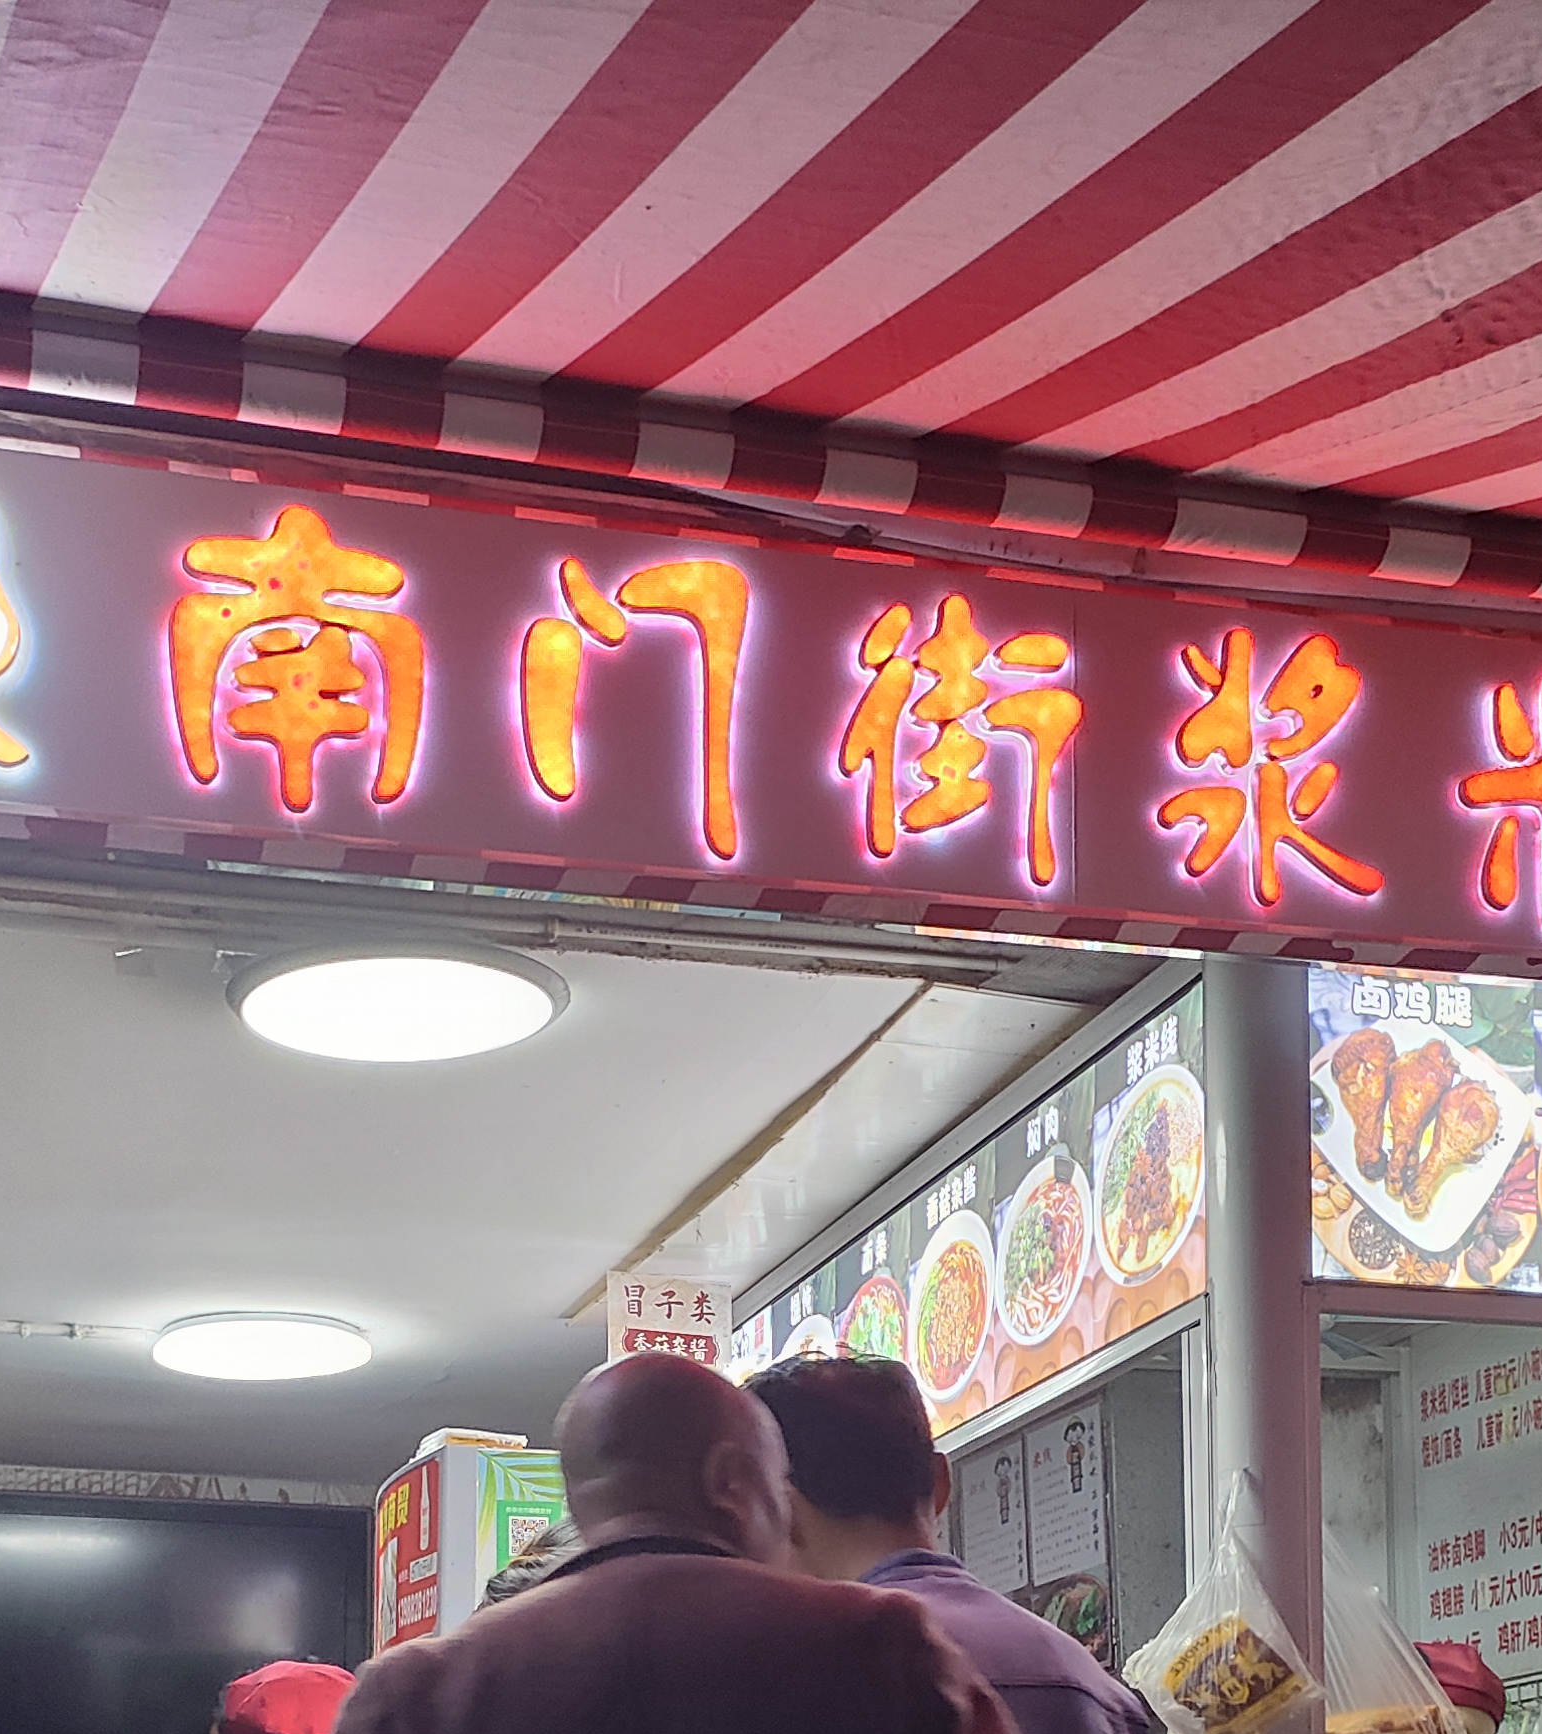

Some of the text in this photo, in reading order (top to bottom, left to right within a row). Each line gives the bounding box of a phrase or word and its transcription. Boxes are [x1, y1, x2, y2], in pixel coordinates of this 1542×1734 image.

[1352, 977, 1472, 1026] 卤鸡腿
[1126, 1016, 1178, 1085] 浆米线
[624, 1284, 717, 1324] 冒子类
